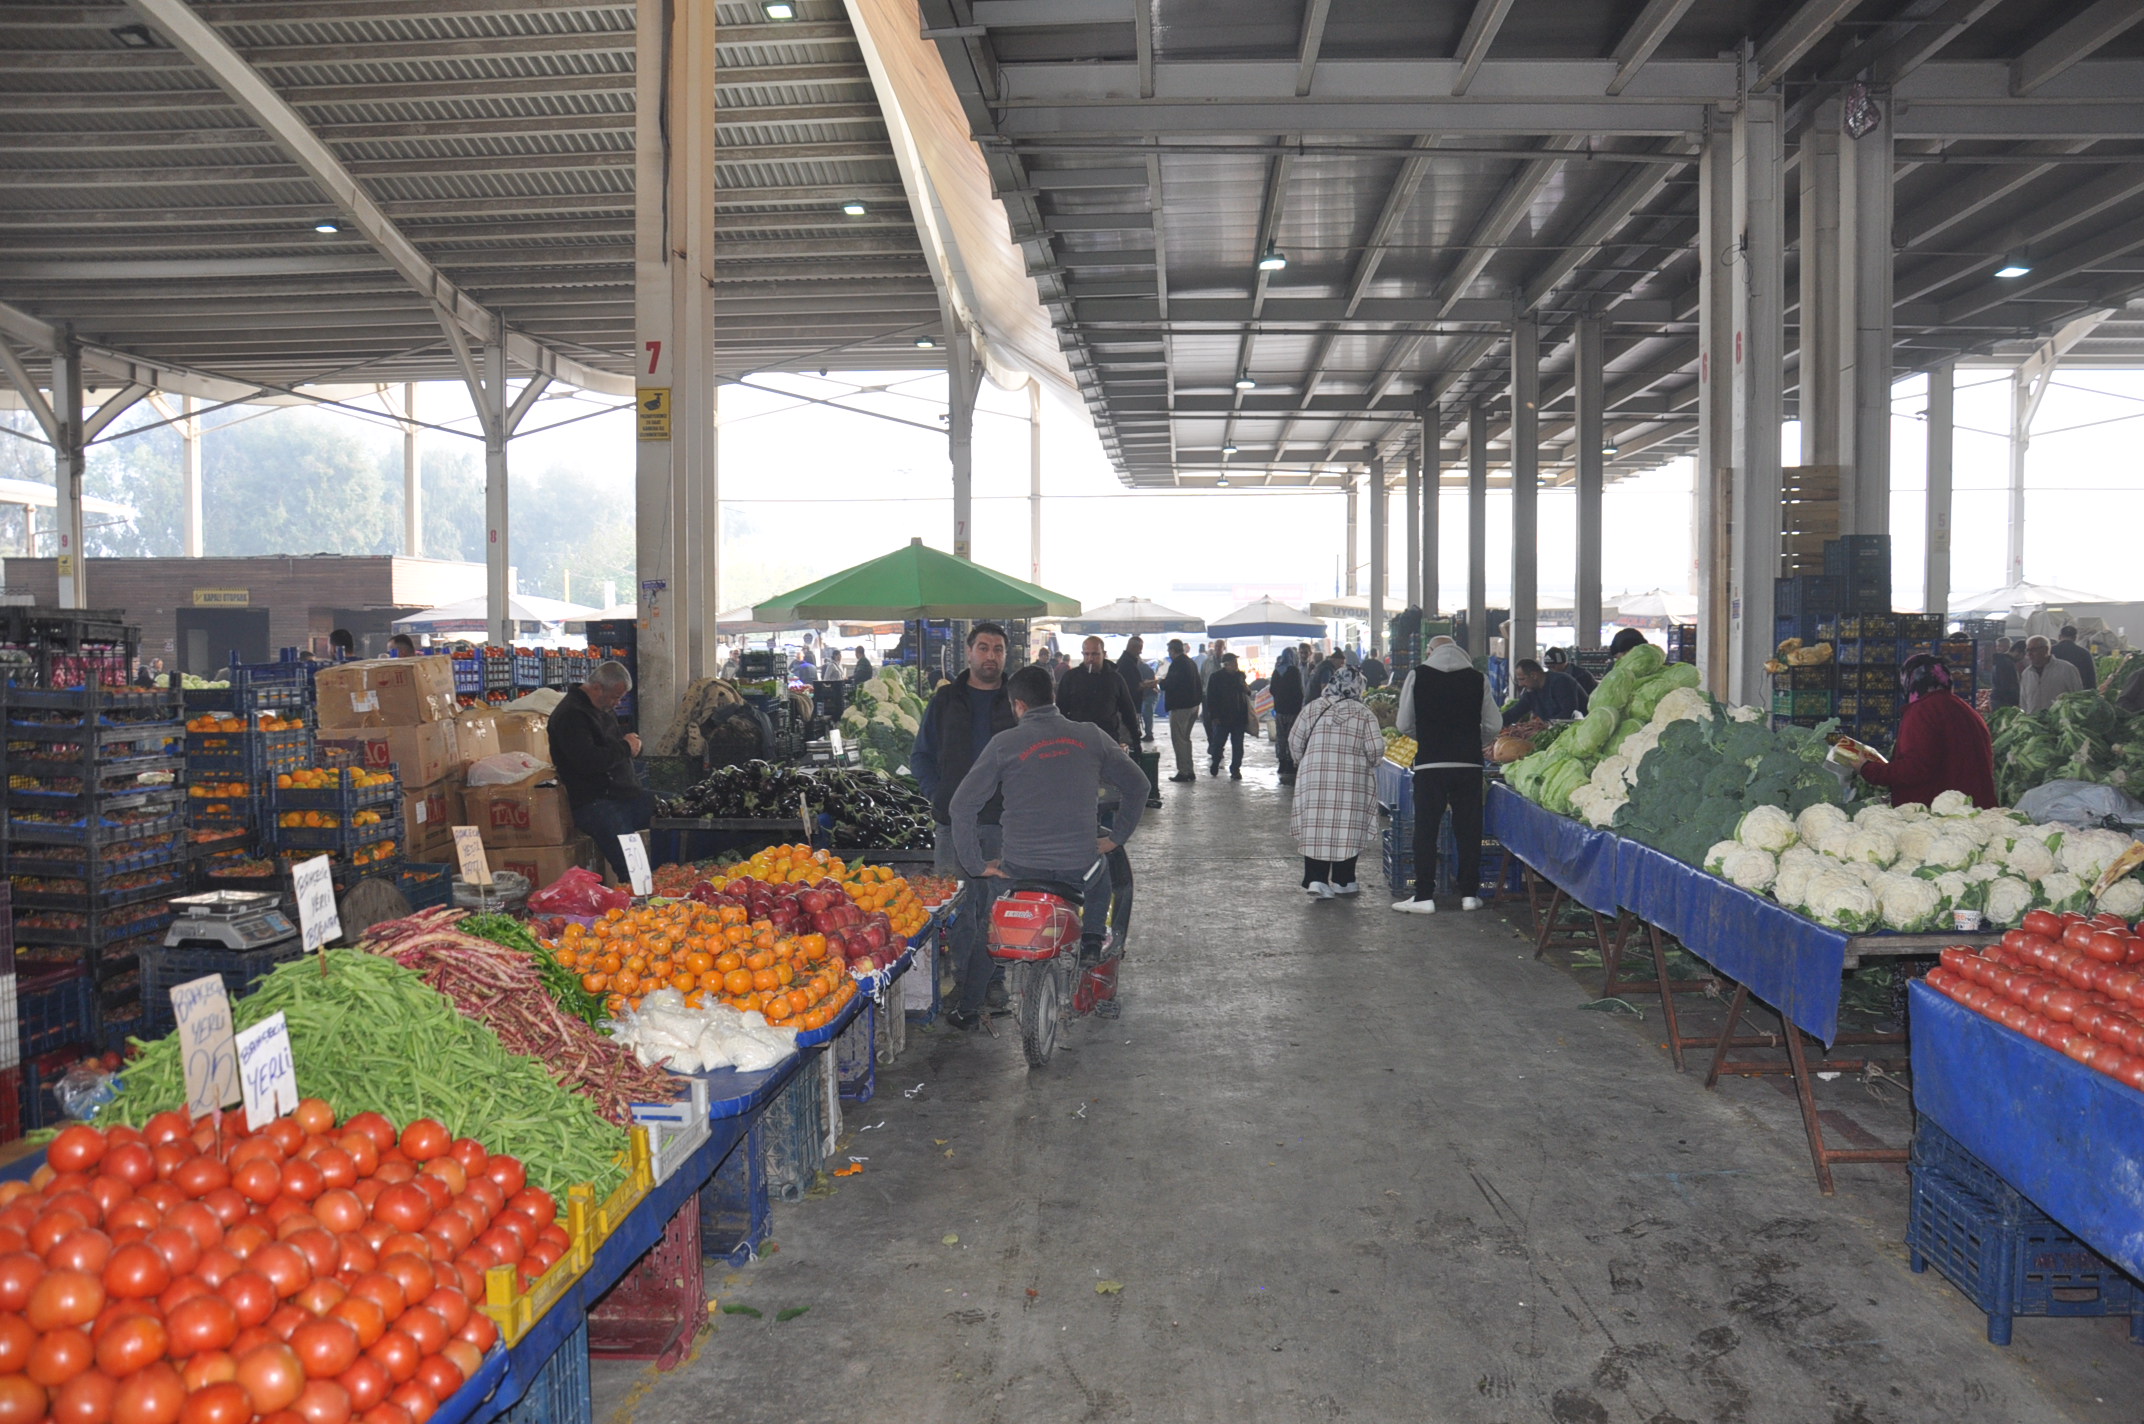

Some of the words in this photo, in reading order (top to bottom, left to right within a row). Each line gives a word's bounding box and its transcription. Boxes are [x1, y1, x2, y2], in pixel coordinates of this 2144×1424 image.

[646, 341, 661, 374] 7
[1736, 330, 1742, 364] 6
[1702, 352, 1708, 384] 6
[62, 534, 68, 548] 9
[490, 530, 497, 543] 8
[958, 521, 965, 535] 7
[1332, 607, 1369, 618] UYGUN
[364, 743, 387, 764] AC
[491, 804, 529, 825] TAC
[192, 1009, 226, 1046] YERLİ
[188, 1035, 236, 1113] 25
[247, 1047, 293, 1110] YERLİ
